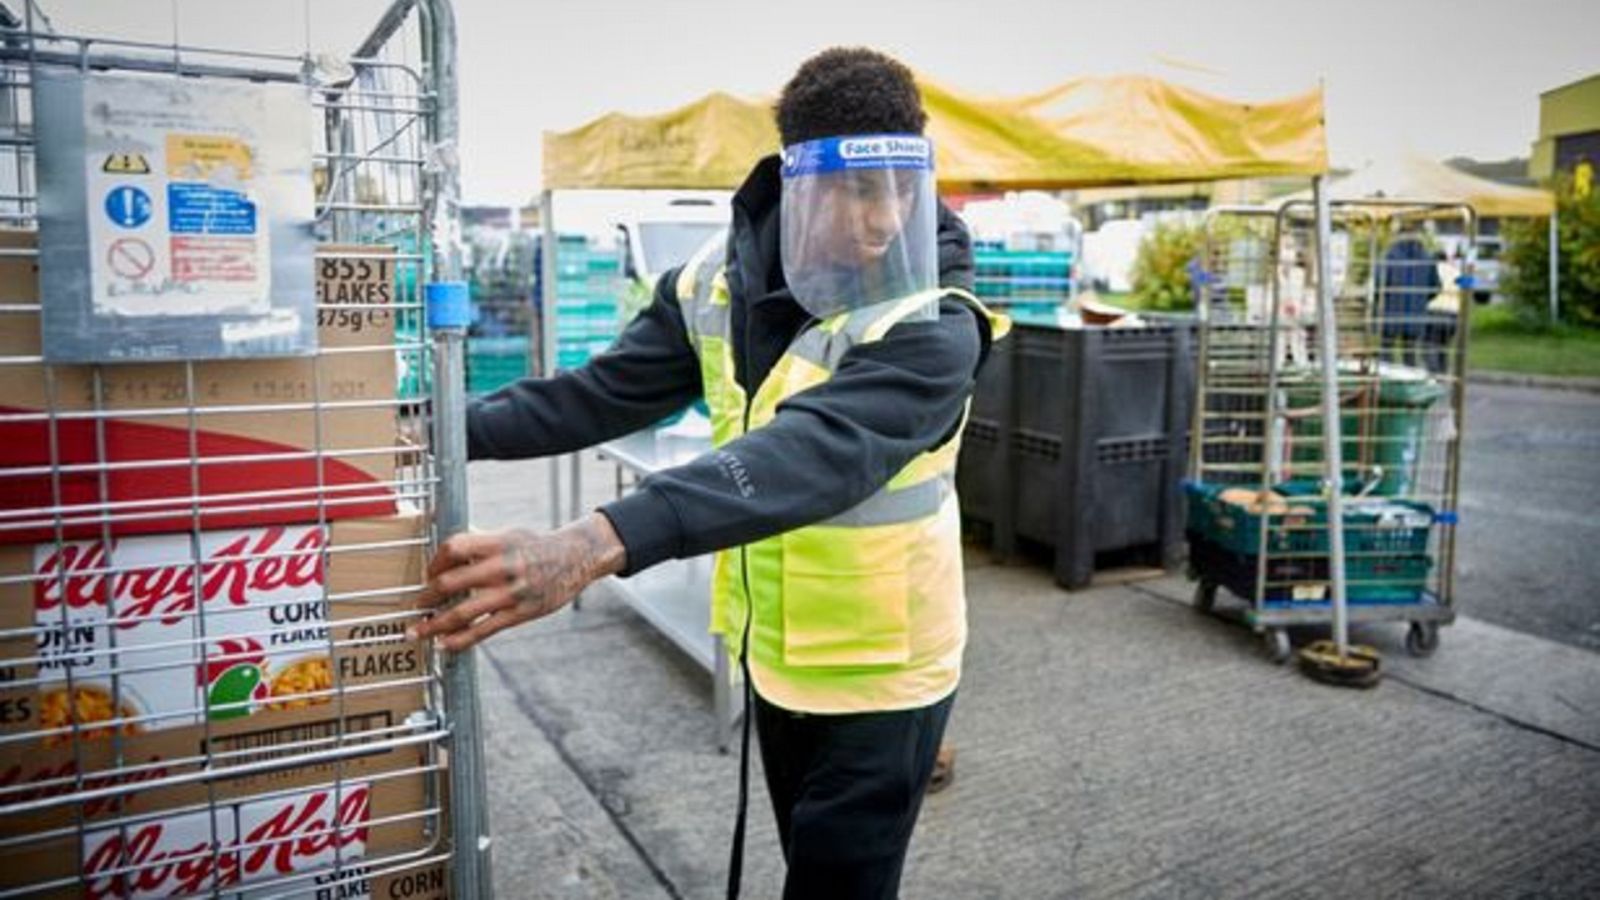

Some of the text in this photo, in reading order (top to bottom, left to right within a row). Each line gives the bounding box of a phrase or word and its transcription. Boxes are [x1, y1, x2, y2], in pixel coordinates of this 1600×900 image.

[845, 142, 882, 156] Face
[340, 649, 416, 679] FLAKES
[389, 867, 443, 900] CORN
